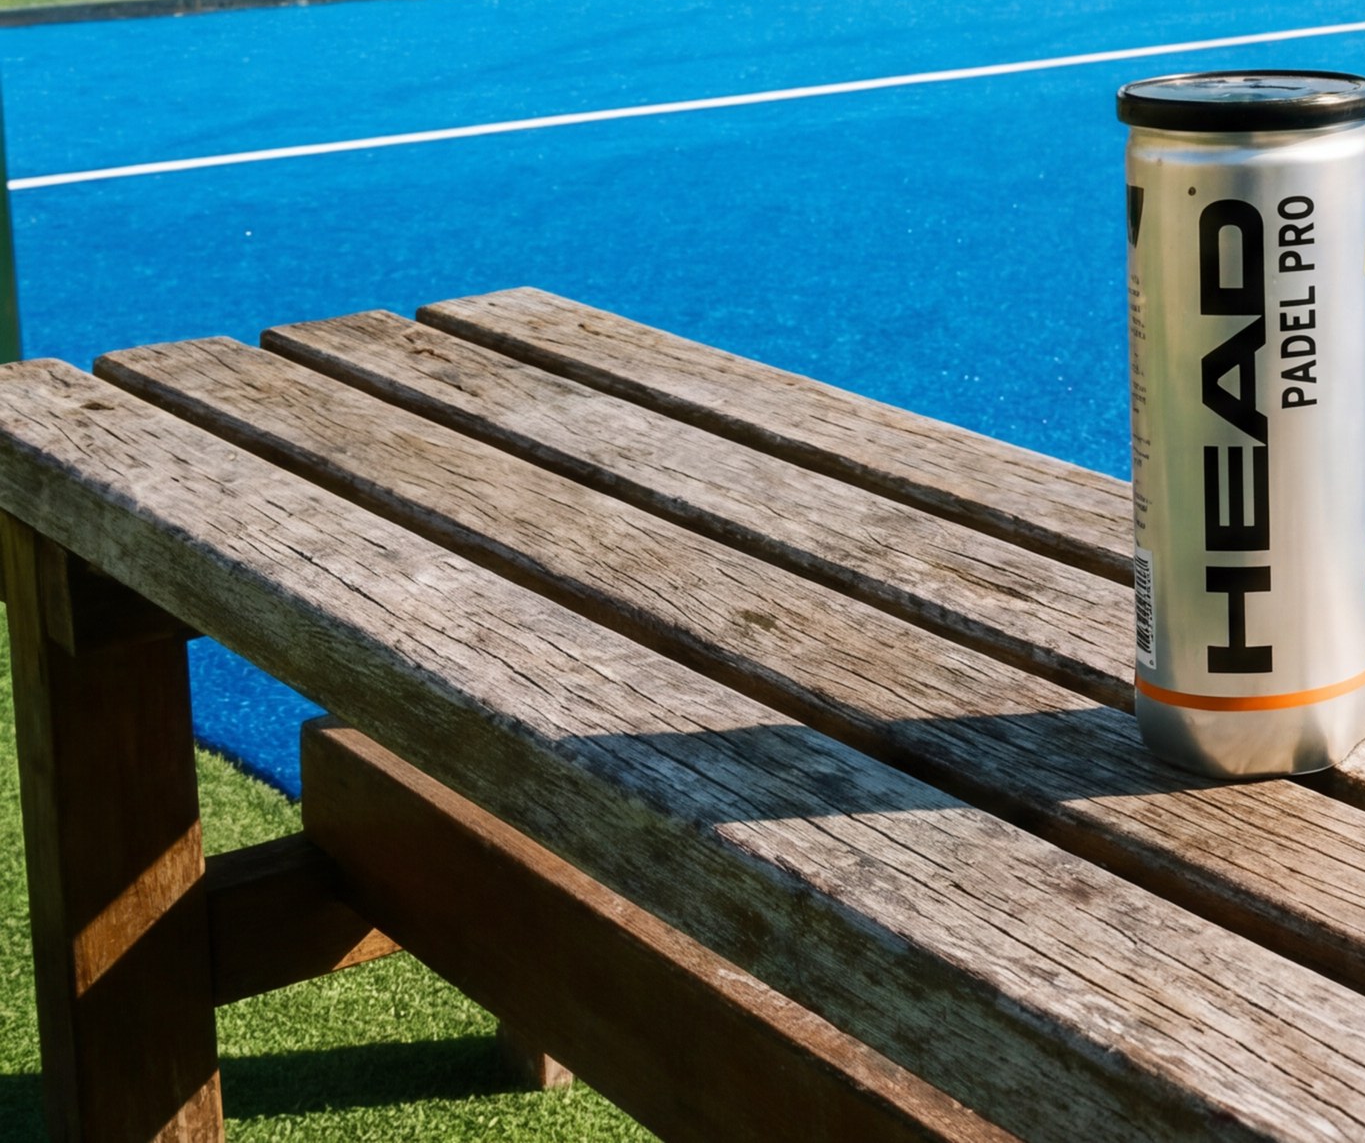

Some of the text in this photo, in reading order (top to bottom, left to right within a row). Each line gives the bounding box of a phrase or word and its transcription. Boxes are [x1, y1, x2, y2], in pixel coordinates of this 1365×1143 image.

[1199, 199, 1273, 674] HEAD
[1277, 195, 1317, 409] PADEL PRO
